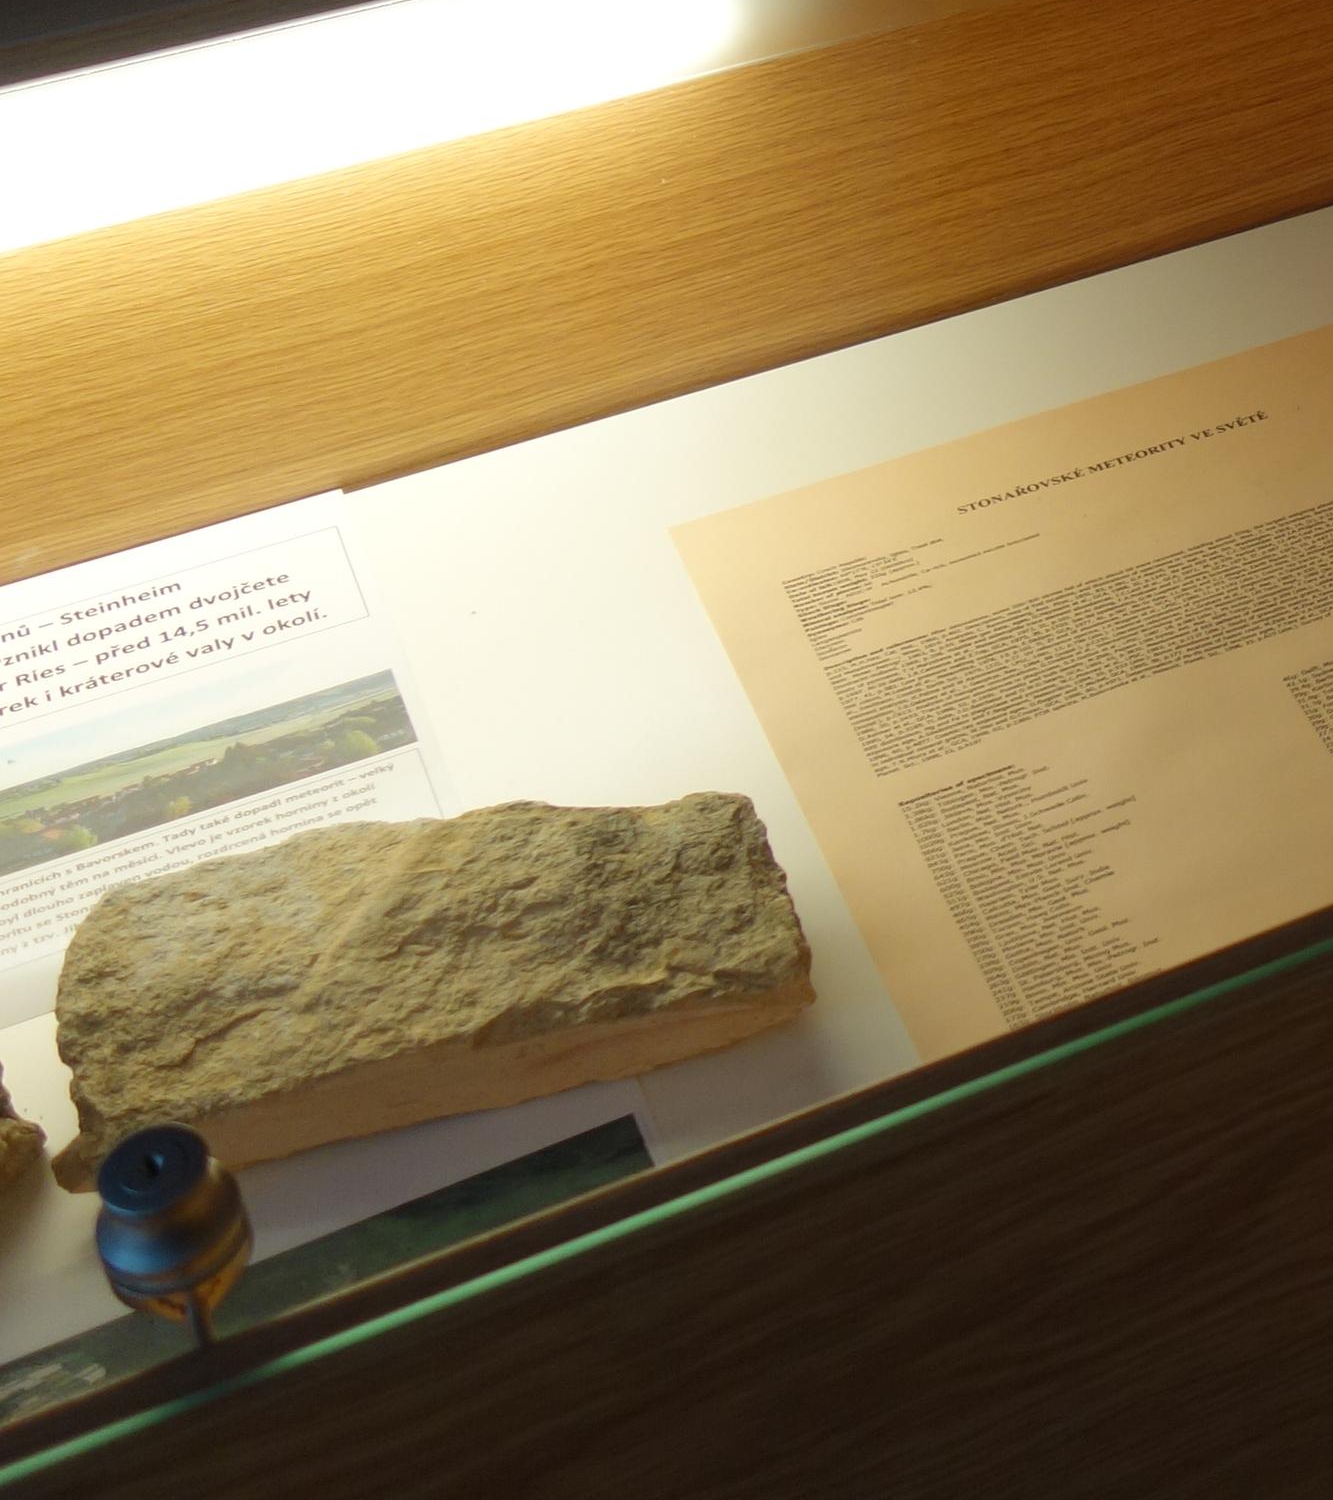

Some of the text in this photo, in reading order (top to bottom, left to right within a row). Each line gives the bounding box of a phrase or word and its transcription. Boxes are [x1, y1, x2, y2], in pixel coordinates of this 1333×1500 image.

[1087, 436, 1185, 473] METEORITY
[1189, 428, 1214, 440] VE
[0, 574, 289, 666] znikl dopadem dvojčete
[15, 590, 310, 686] Ries před 14,5 mil. lety
[59, 582, 181, 625] Steinheim
[59, 651, 179, 697] kráterové
[185, 637, 234, 657] valy
[262, 607, 327, 635] okolí.
